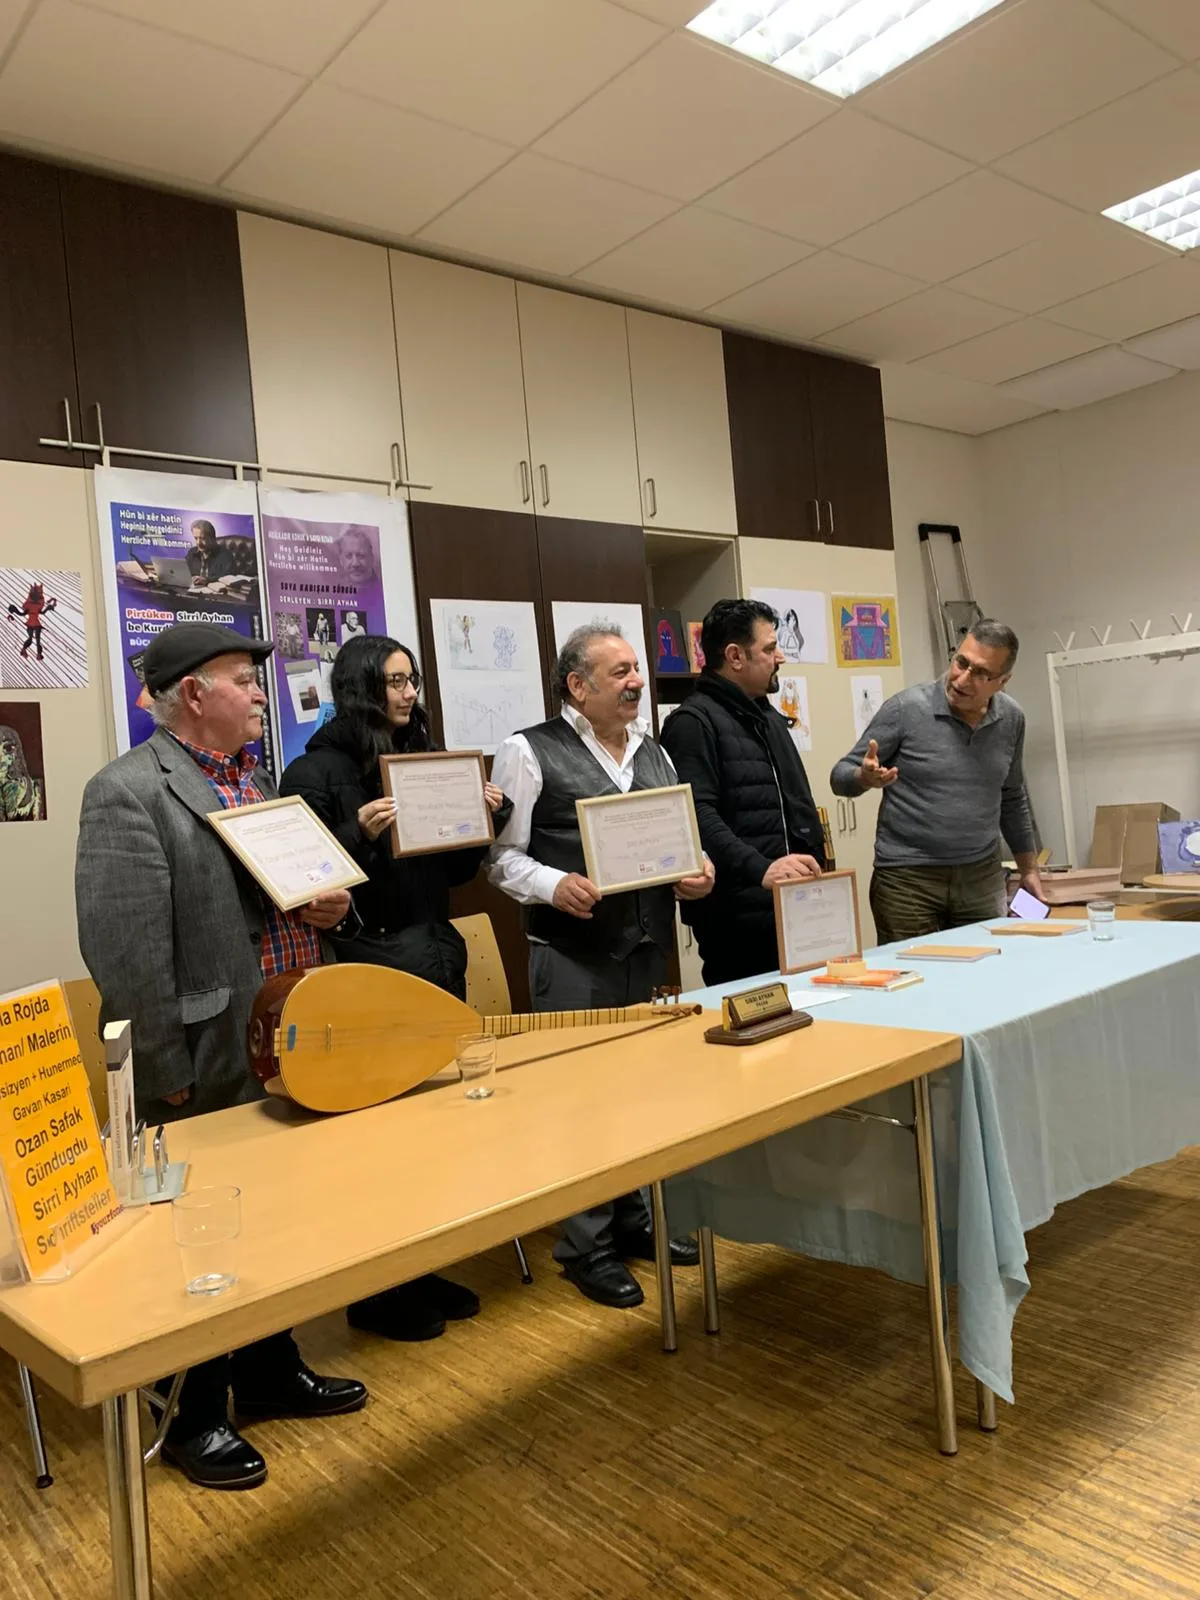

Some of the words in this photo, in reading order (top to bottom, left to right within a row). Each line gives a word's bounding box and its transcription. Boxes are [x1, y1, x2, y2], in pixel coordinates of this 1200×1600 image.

[127, 622, 140, 632] be
[201, 612, 234, 623] Ayhan
[13, 996, 50, 1021] Rojda
[27, 1024, 72, 1053] Malerin
[13, 1099, 43, 1121] Gavan
[43, 1083, 71, 1106] Kasari
[15, 1130, 49, 1158] Ozan
[50, 1106, 83, 1137] Safak
[26, 1137, 88, 1186] Gündugdu
[33, 1188, 61, 1220] Sirri
[64, 1166, 98, 1200] Ayhan
